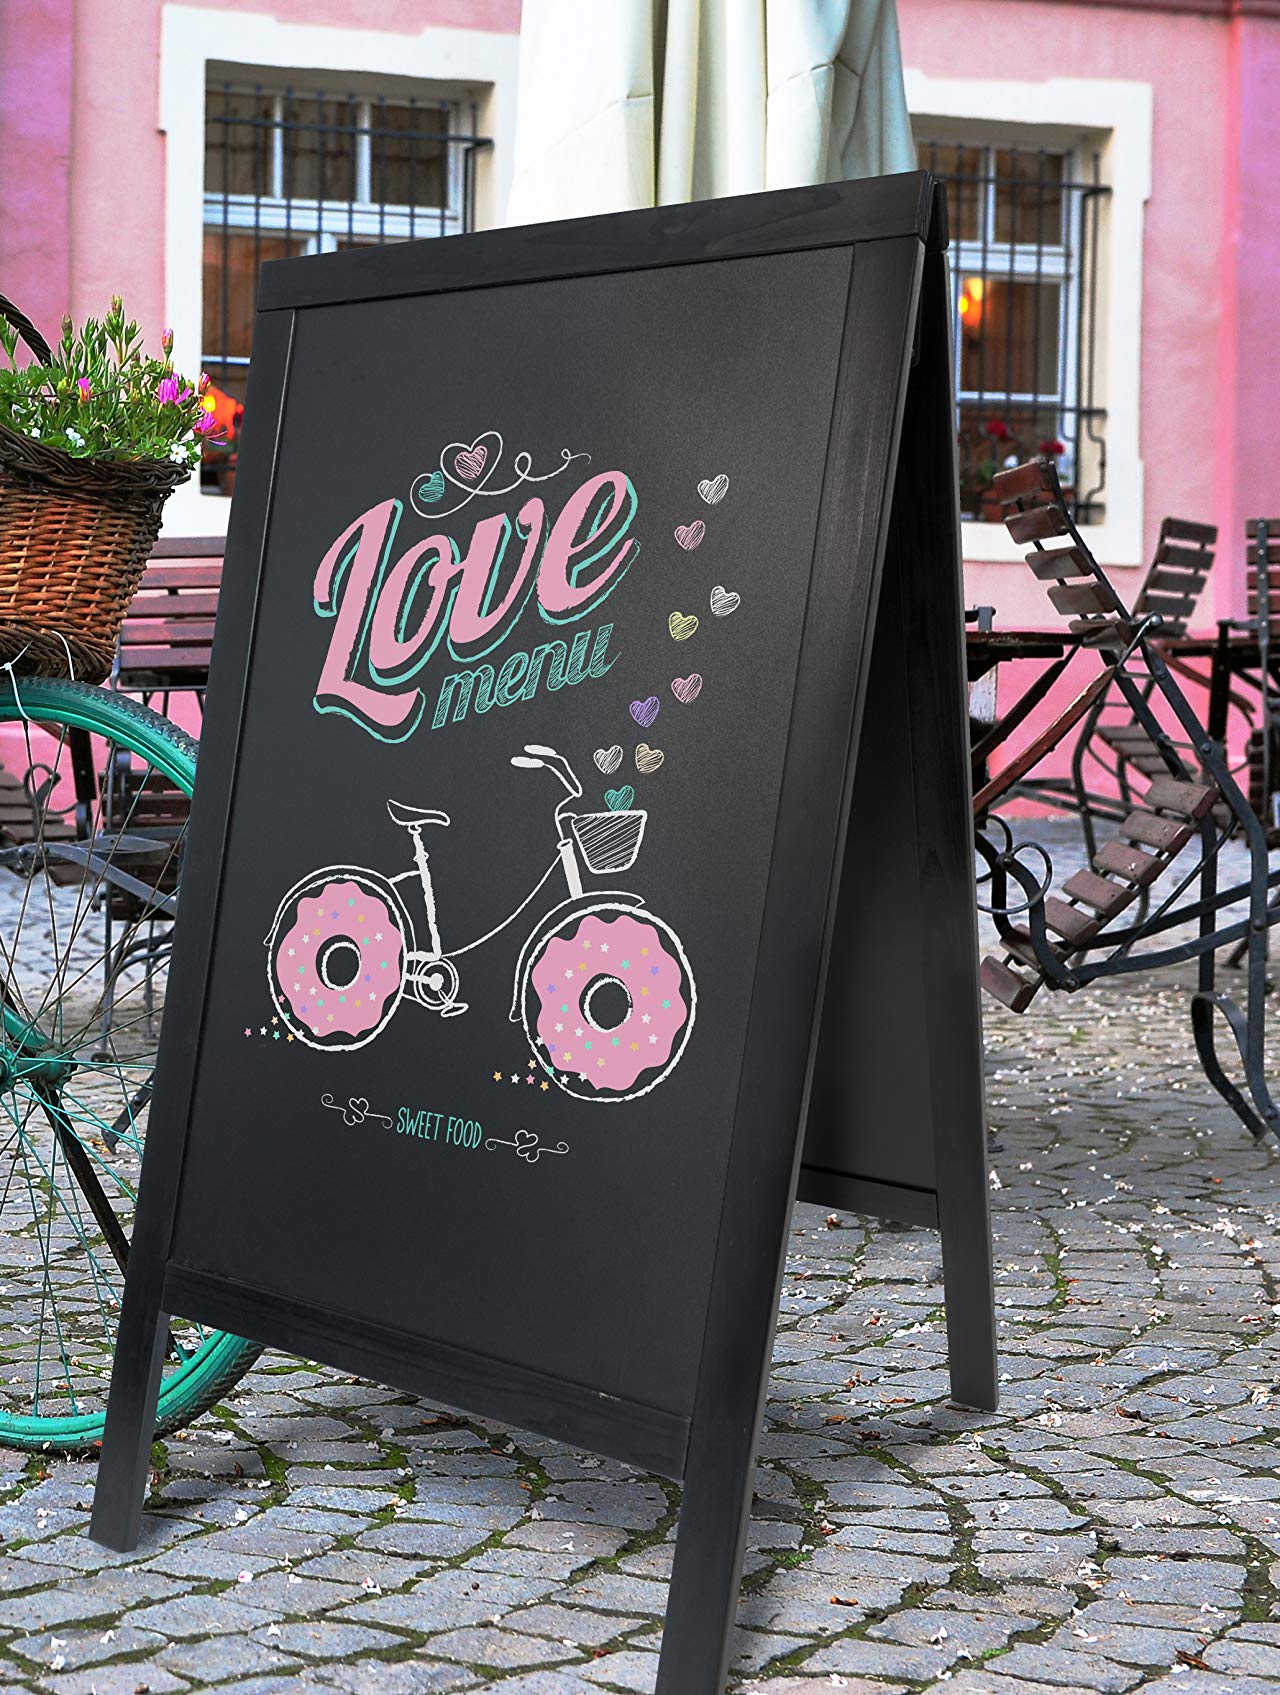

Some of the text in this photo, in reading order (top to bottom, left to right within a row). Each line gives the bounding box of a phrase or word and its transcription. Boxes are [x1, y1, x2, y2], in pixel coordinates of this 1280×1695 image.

[313, 470, 641, 743] Love
[431, 622, 621, 729] menu
[396, 1106, 483, 1149] SWEET FOOD
